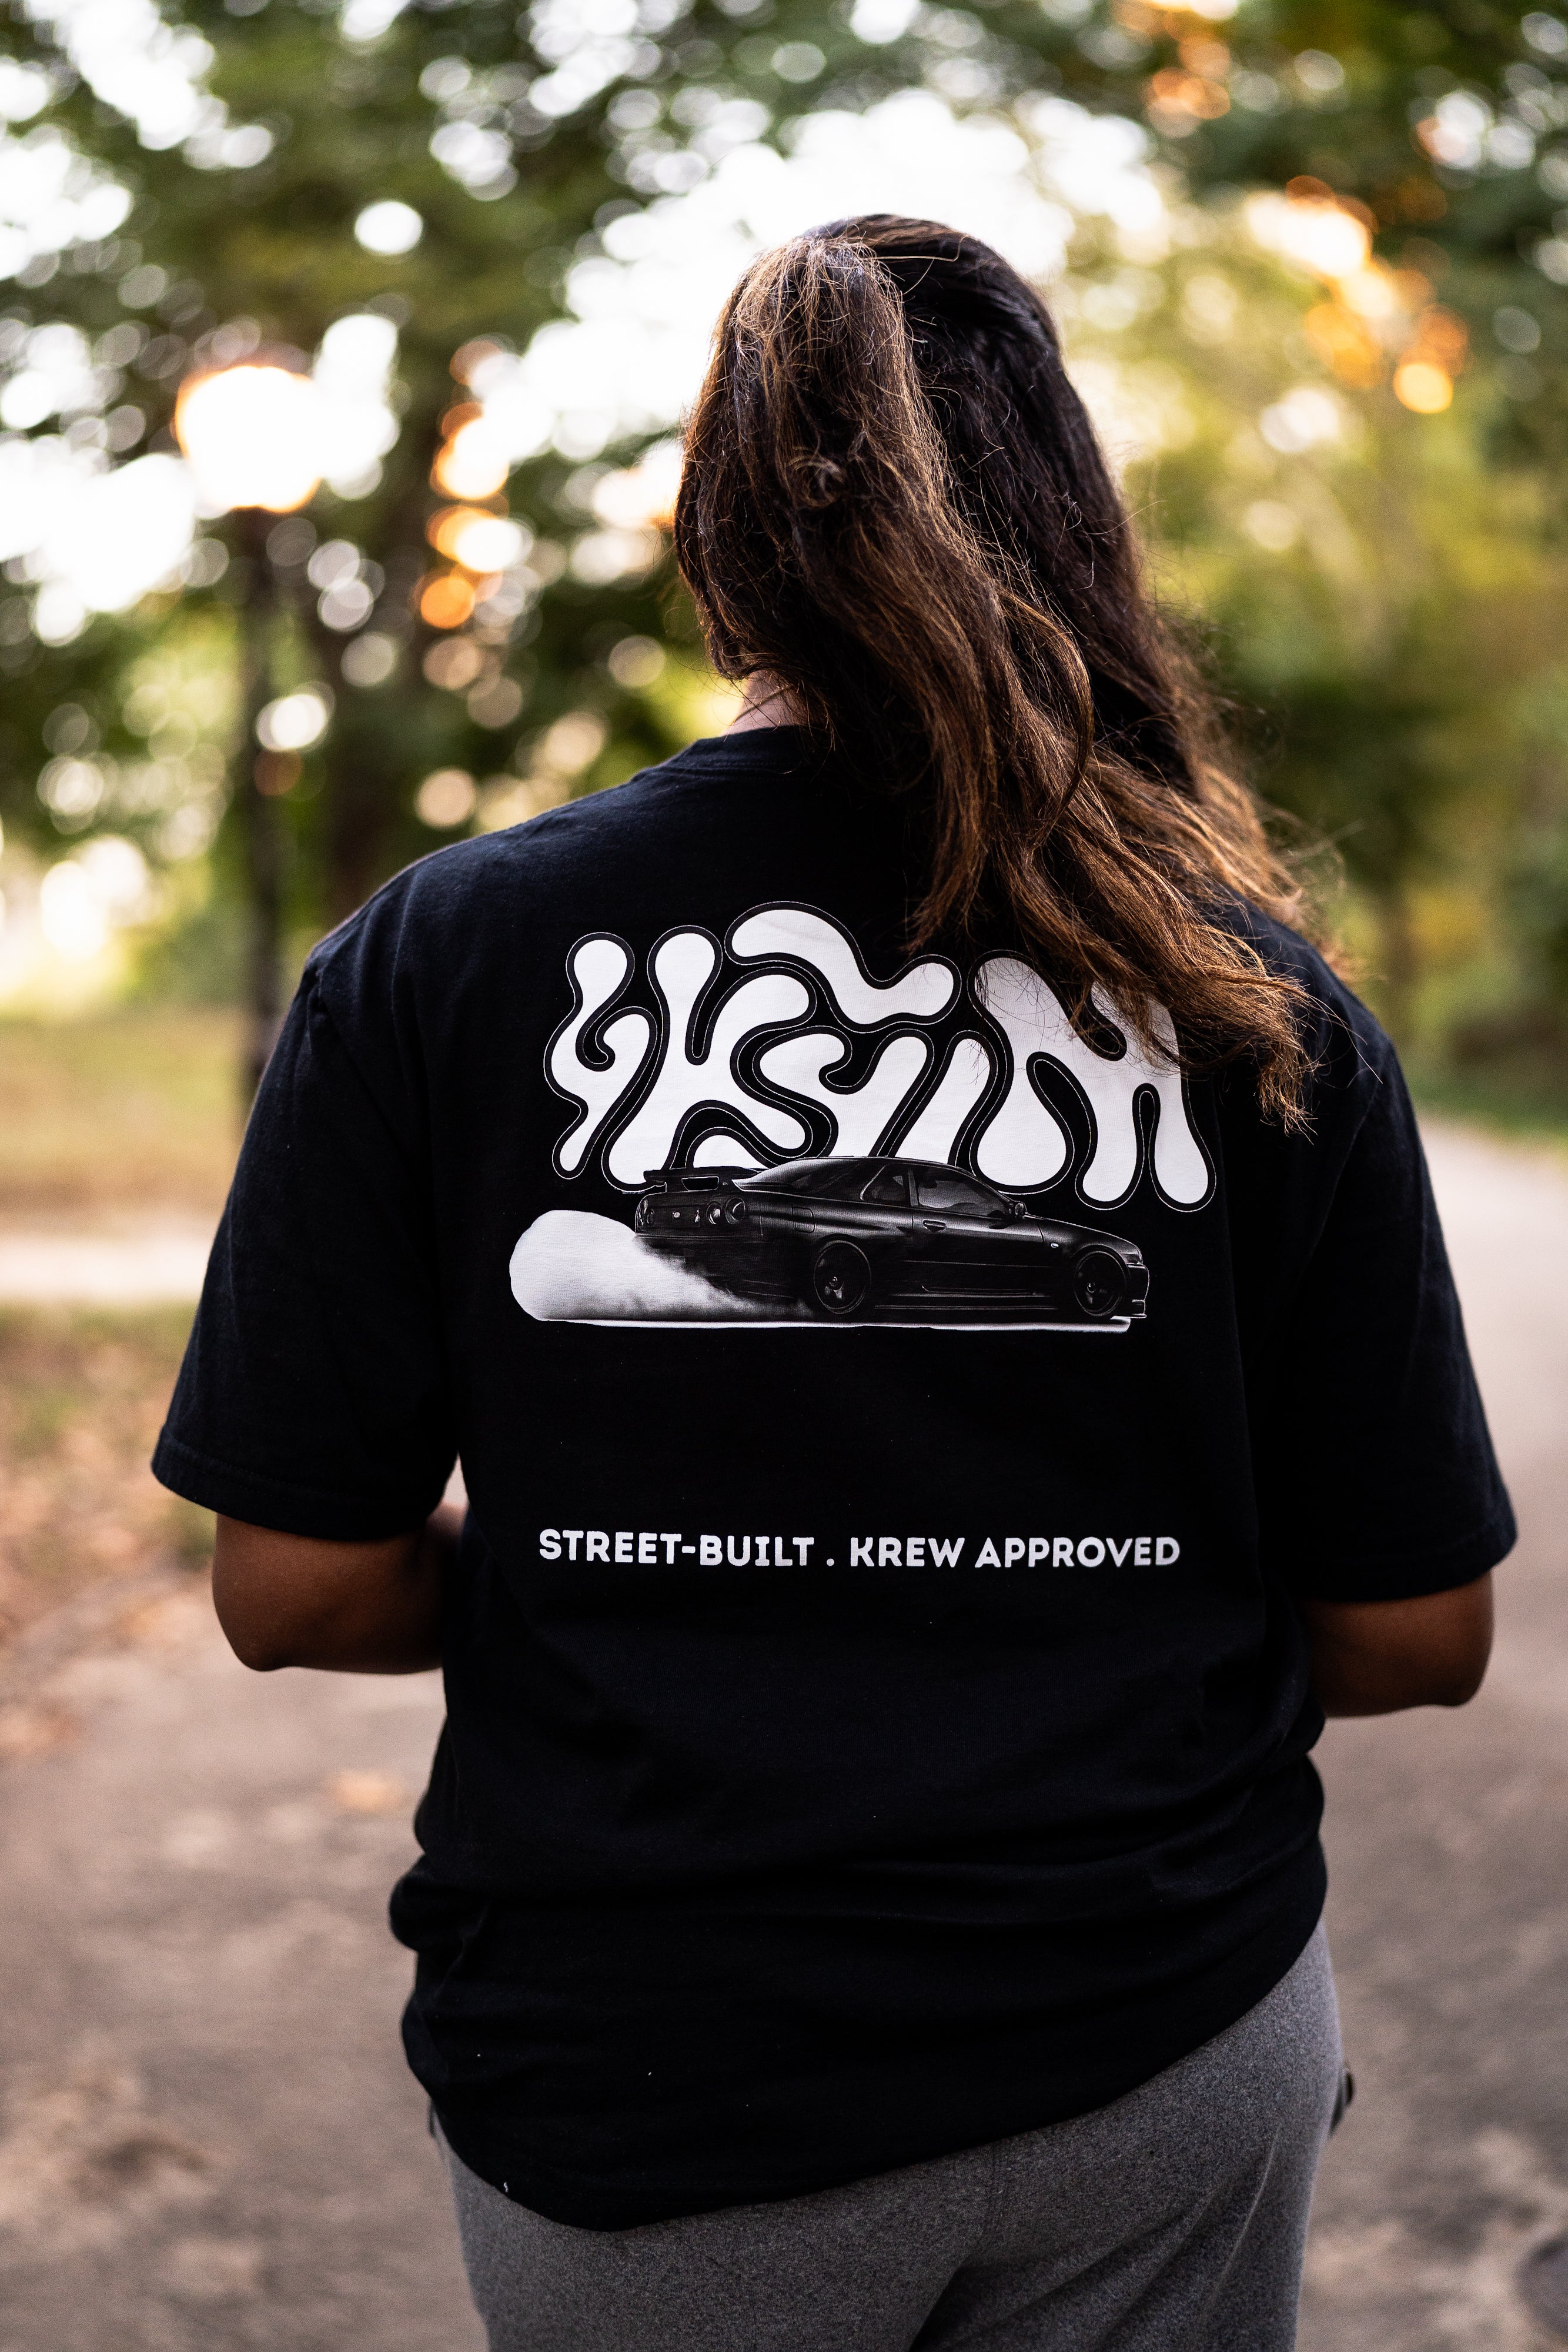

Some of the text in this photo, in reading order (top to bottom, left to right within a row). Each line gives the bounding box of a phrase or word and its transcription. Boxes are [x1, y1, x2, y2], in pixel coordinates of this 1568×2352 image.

[539, 1528, 815, 1567] STREET-BUILT
[850, 1536, 966, 1568] KREW
[974, 1536, 1181, 1569] APPROVED
